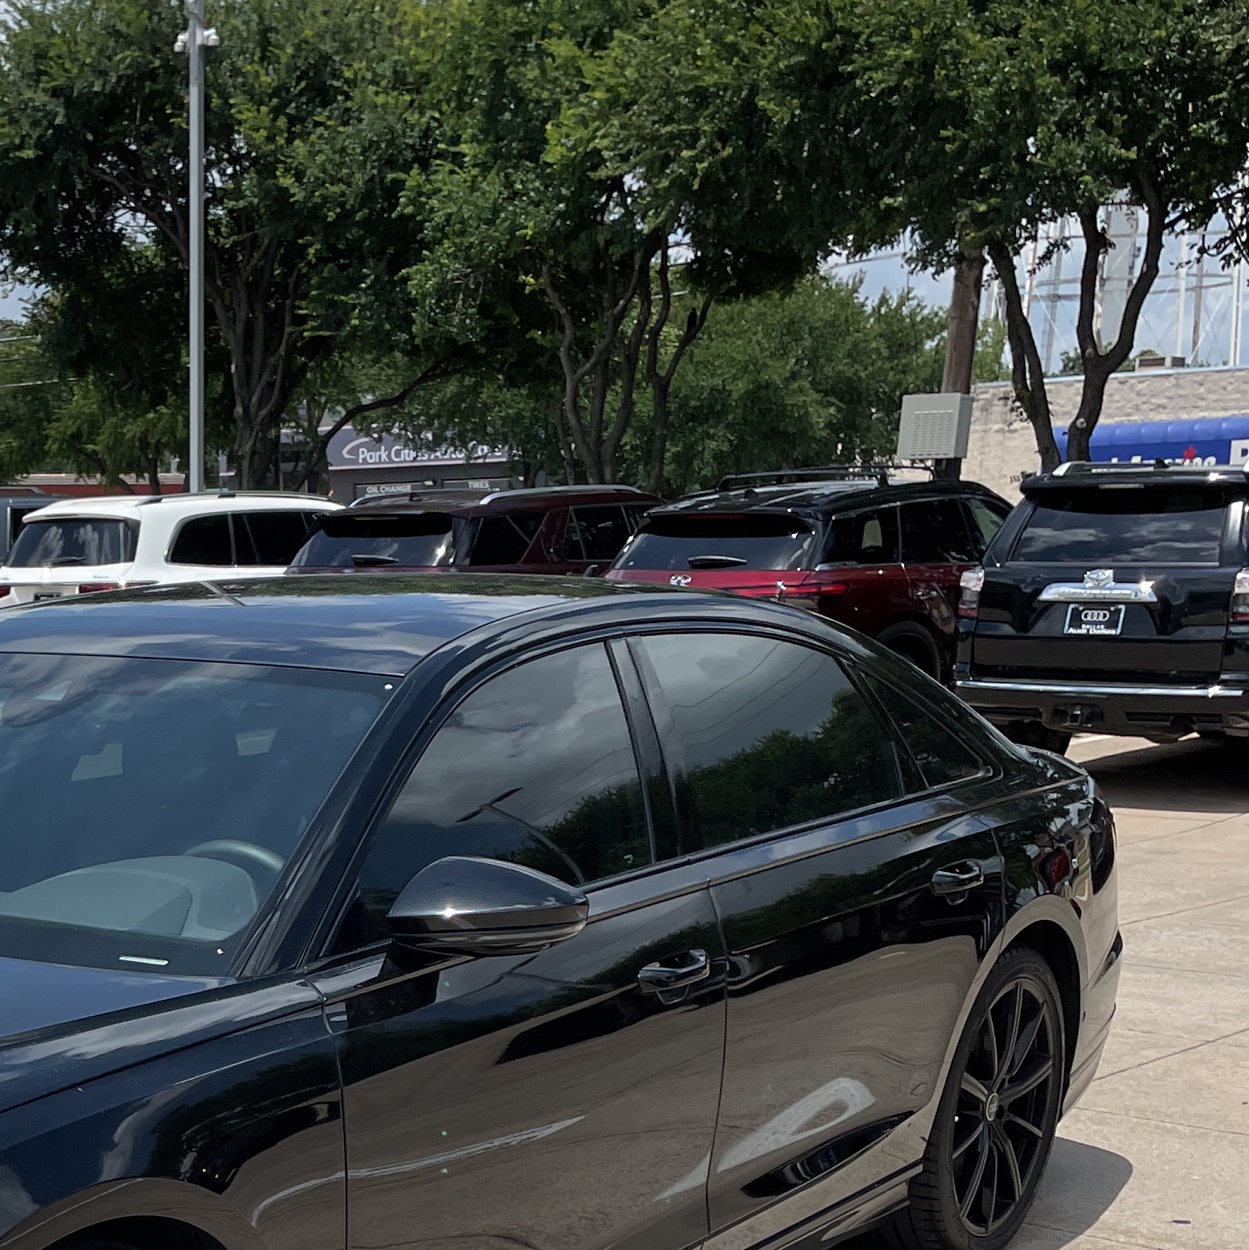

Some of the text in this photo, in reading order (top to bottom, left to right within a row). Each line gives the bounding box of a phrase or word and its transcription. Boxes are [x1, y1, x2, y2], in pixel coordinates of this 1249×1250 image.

[358, 446, 389, 464] Park
[391, 445, 428, 462] Cities
[366, 485, 412, 494] OIL CHANGE
